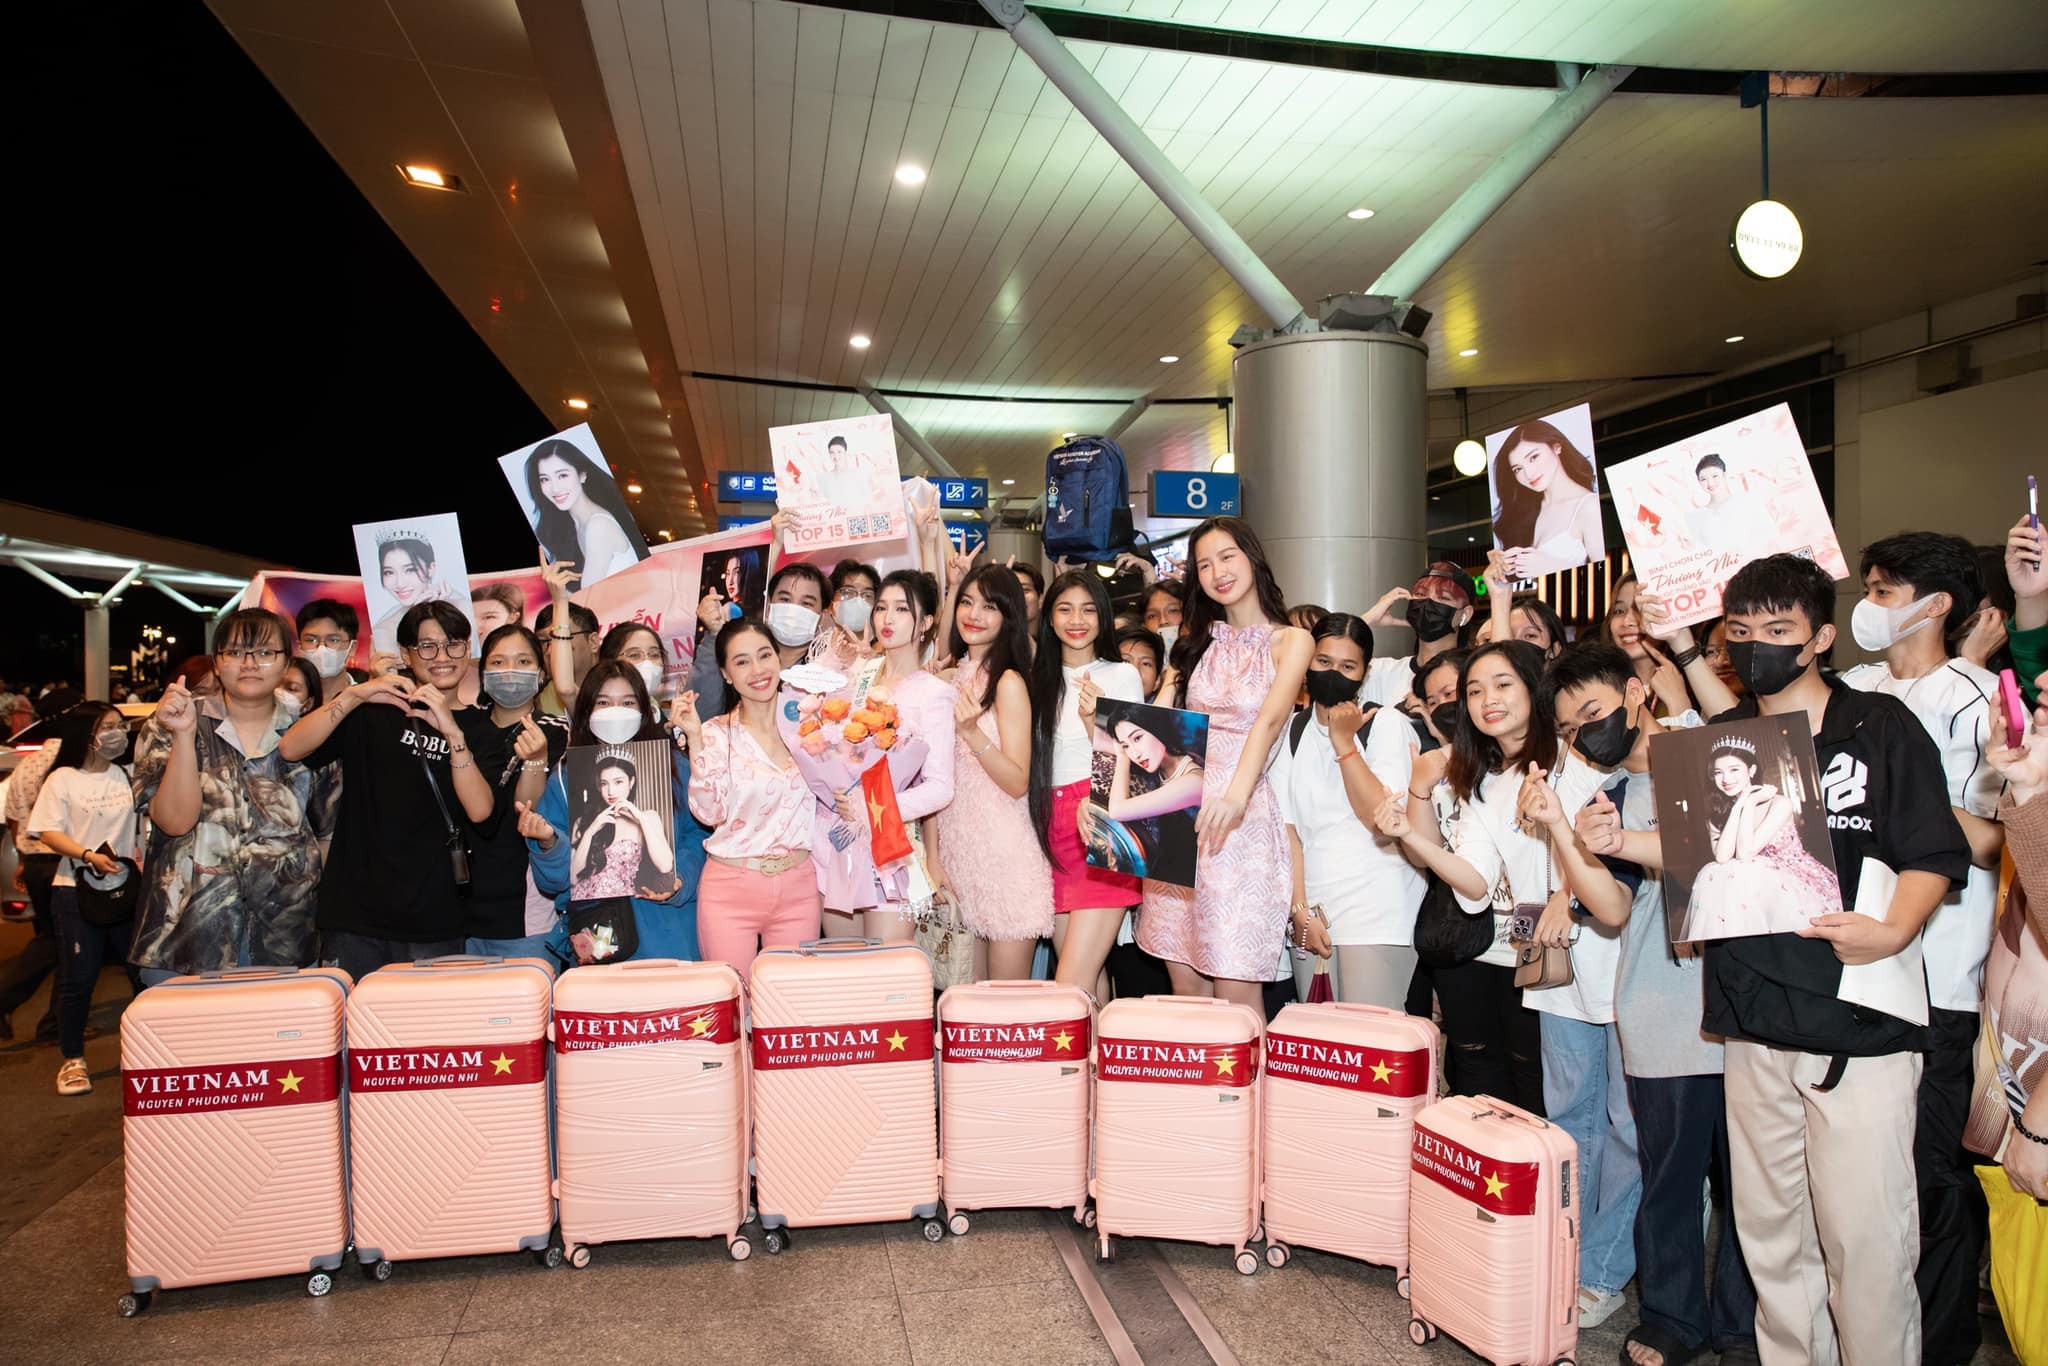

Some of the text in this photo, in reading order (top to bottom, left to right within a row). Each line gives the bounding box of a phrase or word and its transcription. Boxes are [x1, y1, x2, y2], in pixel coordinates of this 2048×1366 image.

[1186, 478, 1208, 510] 8
[1220, 501, 1234, 510] 2F
[793, 525, 844, 542] TOP 15
[1664, 588, 1707, 617] TOP
[560, 1015, 680, 1036] VIETNAM
[945, 1027, 1046, 1042] VIETNAM
[565, 1040, 604, 1050] NGUYEN
[762, 1028, 880, 1050] VIETNAM
[356, 1051, 483, 1071] VIETNAM
[768, 1050, 875, 1064] NGUYEN PHUONG NHI
[949, 1047, 1042, 1057] NGUYEN PHUONG NHI
[1102, 1043, 1206, 1063] VIETNAM
[1266, 1038, 1364, 1068] VIETNAM
[130, 1069, 270, 1094] VIETNAM
[363, 1073, 478, 1086] NGUYEN PHUONG NHI
[1105, 1064, 1202, 1079] NGUYEN PHUONG NHI
[1267, 1060, 1359, 1084] NGUYEN PHUONG NHI
[137, 1092, 264, 1110] NGUYEN PHUONG NHI
[1434, 1160, 1461, 1184] PHUONG
[1461, 1177, 1476, 1190] NHI
